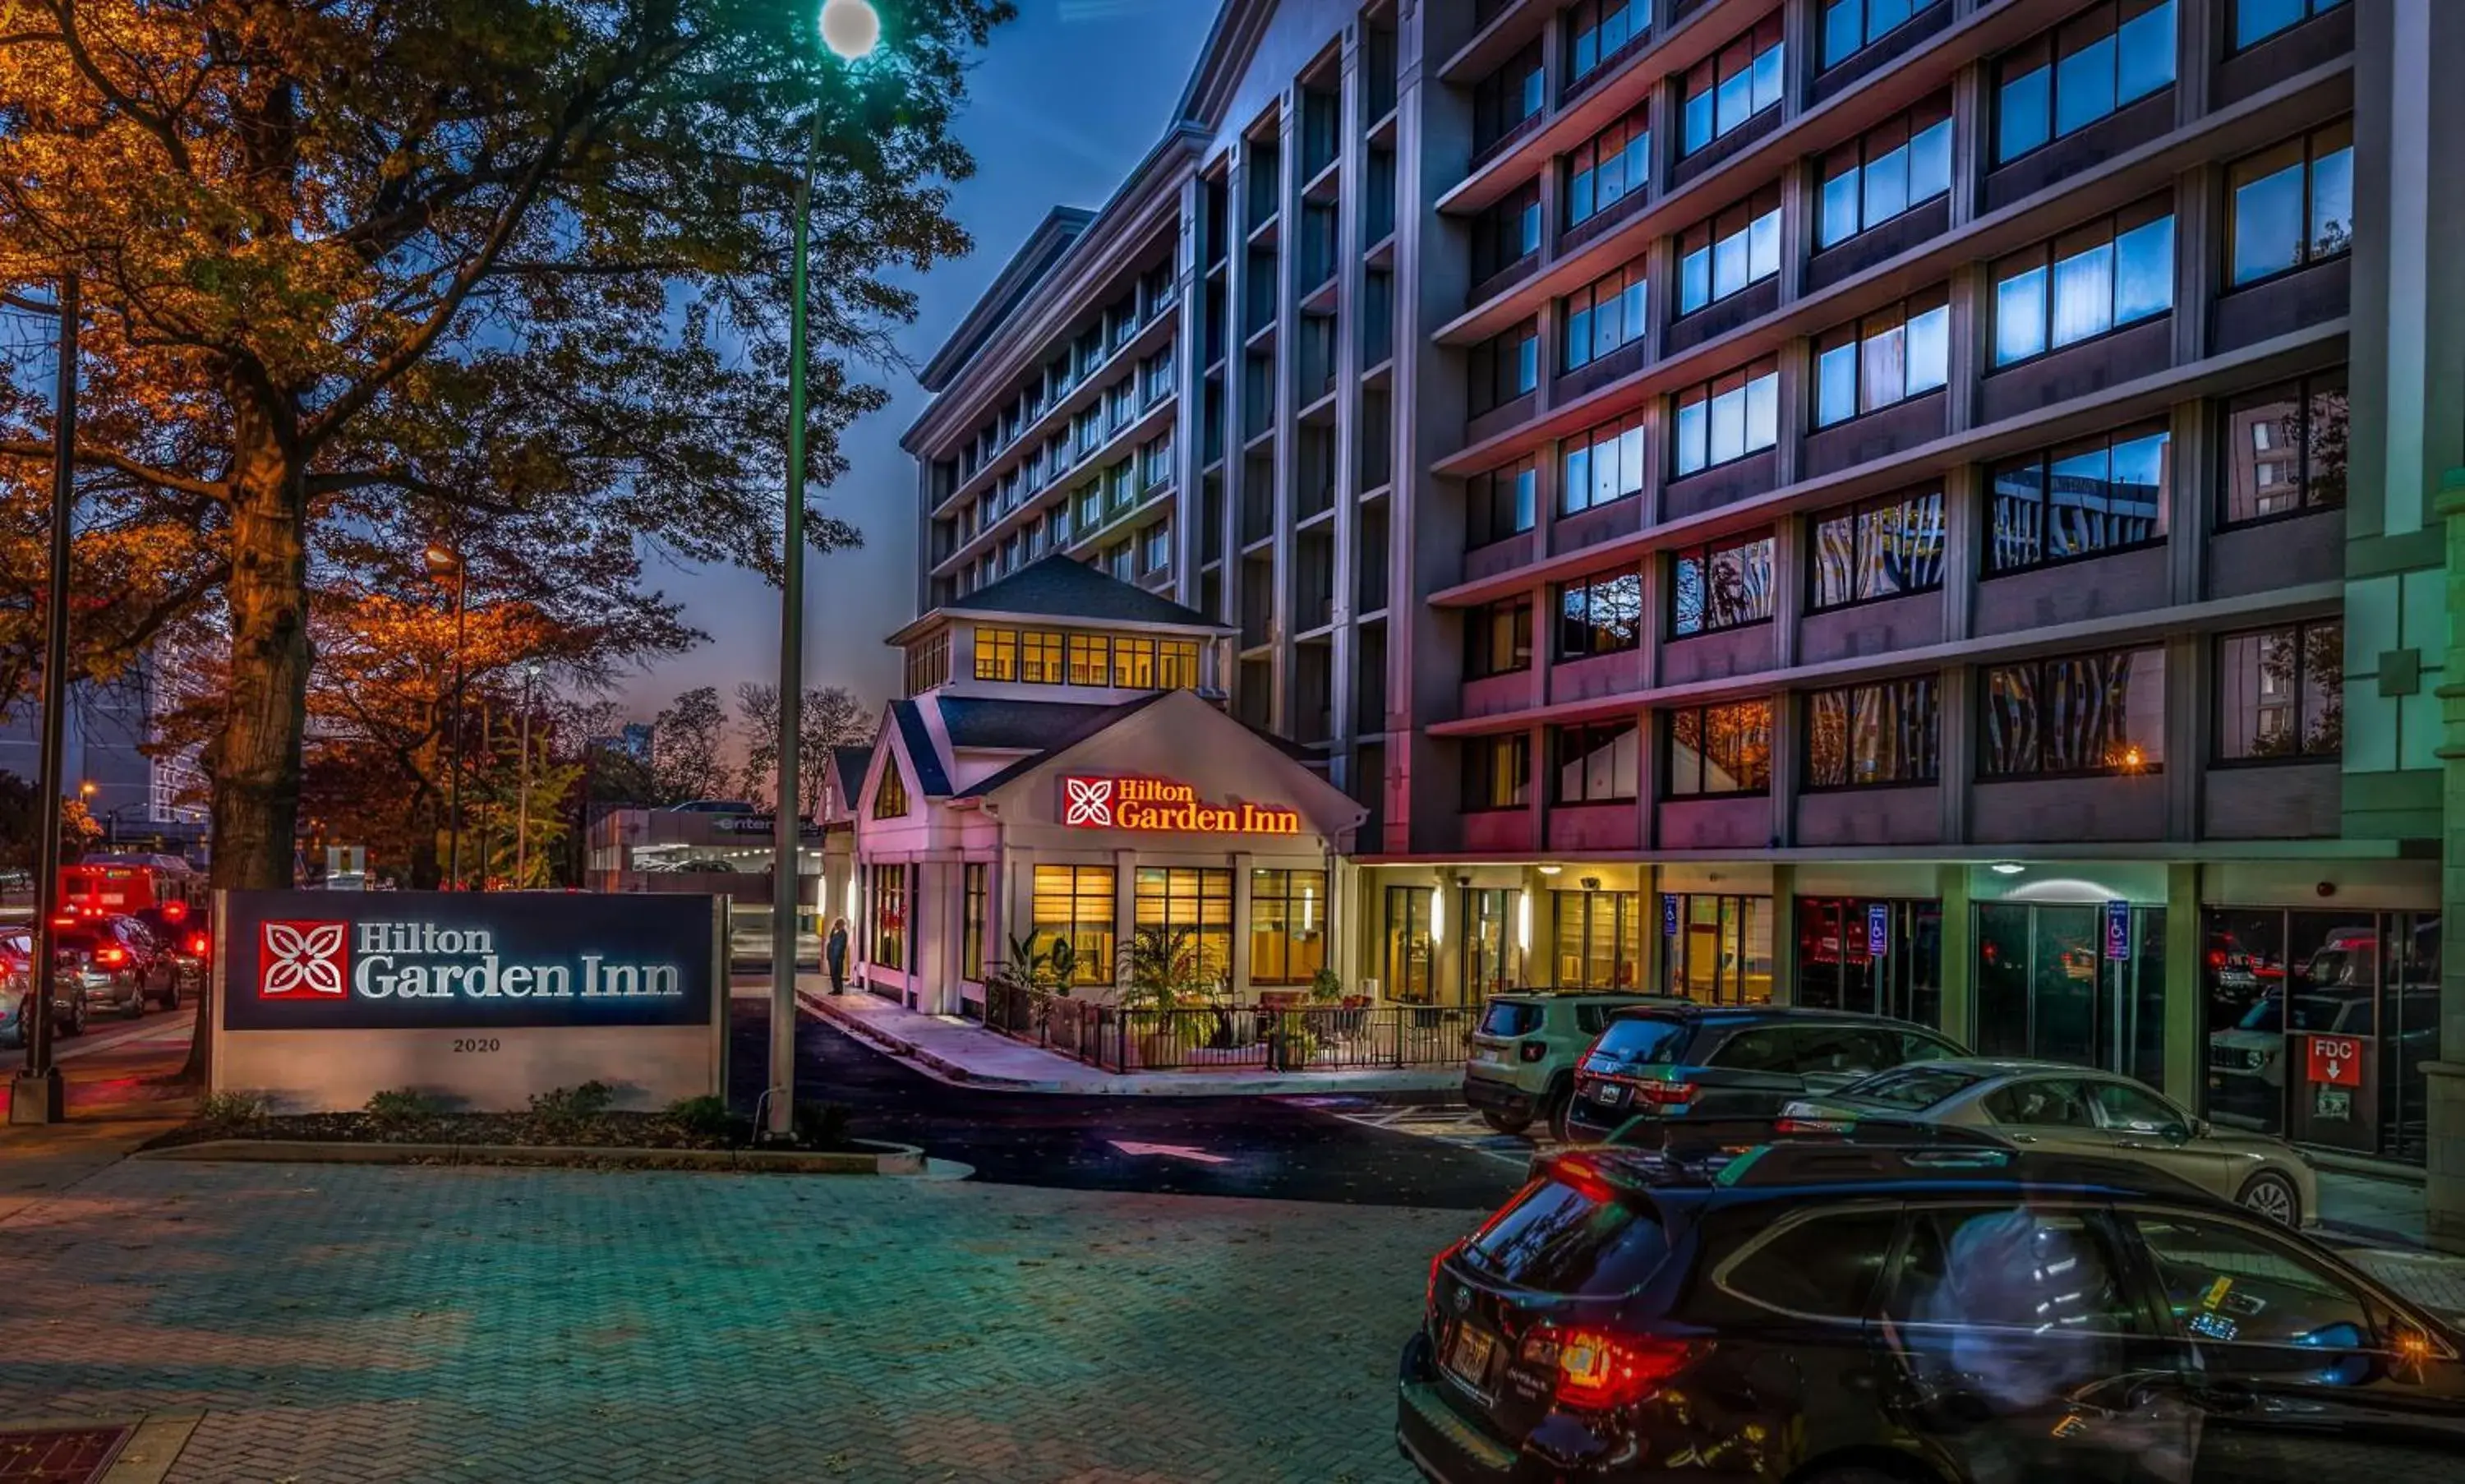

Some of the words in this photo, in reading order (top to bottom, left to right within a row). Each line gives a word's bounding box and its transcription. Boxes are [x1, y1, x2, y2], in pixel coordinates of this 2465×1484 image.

[1118, 781, 1193, 801] Hilton
[1117, 801, 1237, 832] Garden
[1242, 804, 1298, 832] Inn
[357, 923, 493, 954] Hilton
[355, 956, 574, 998] Garden
[581, 956, 683, 996] Inn
[454, 1038, 500, 1053] 2020
[2315, 1040, 2352, 1058] FDC
